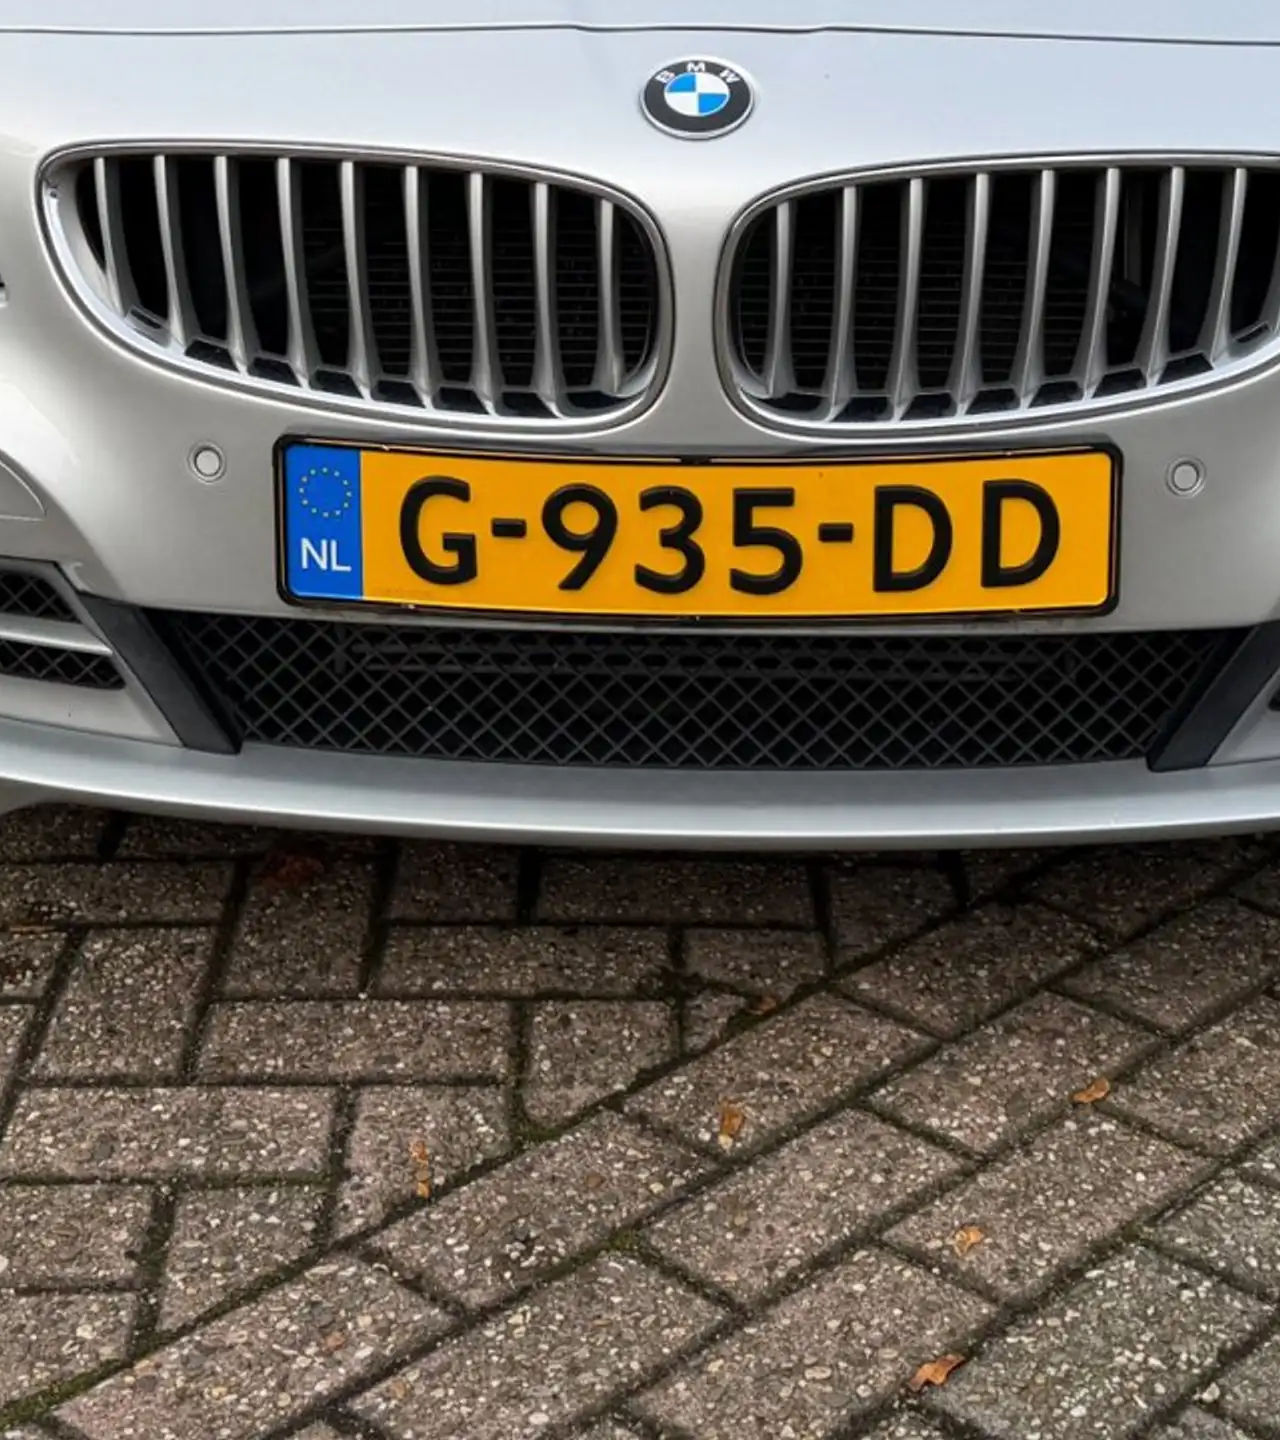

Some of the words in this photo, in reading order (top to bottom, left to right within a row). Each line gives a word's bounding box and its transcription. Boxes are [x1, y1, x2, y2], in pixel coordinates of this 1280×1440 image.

[654, 61, 741, 84] BMW
[398, 474, 1062, 597] G-935-DD
[300, 537, 353, 573] NL
